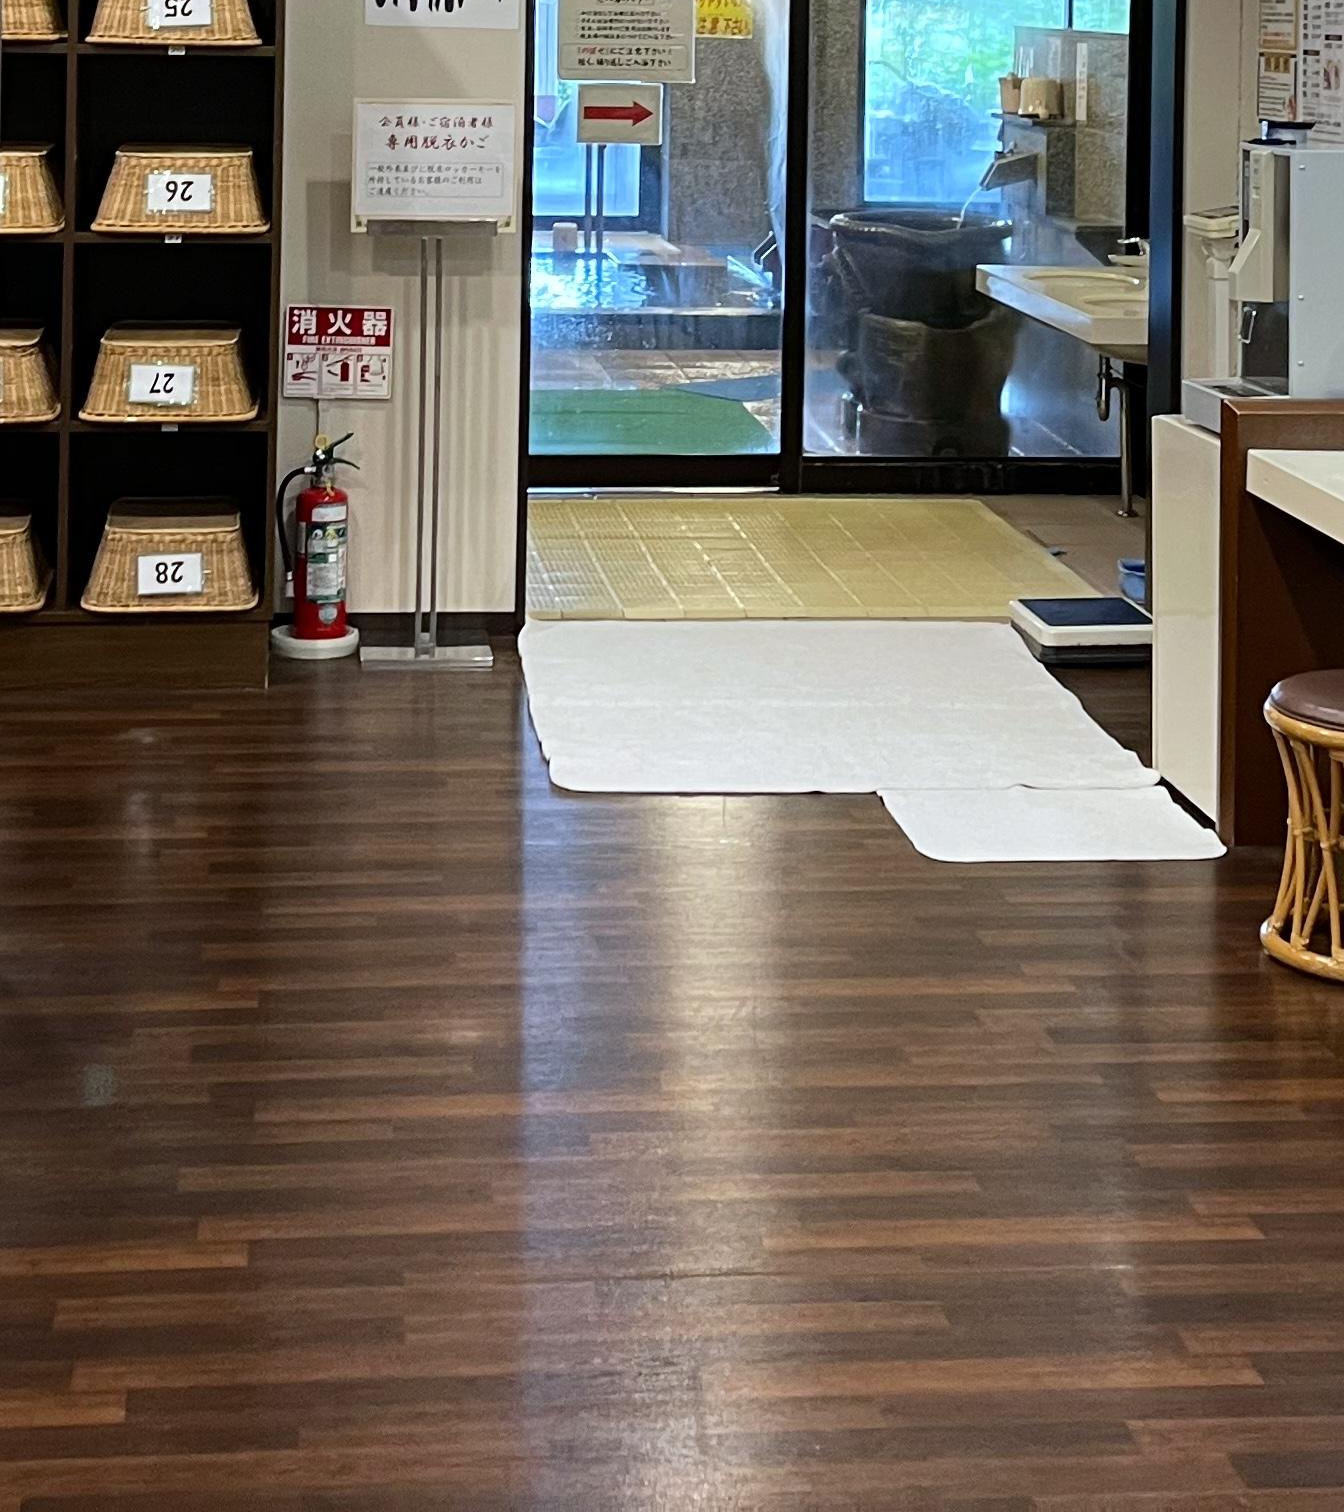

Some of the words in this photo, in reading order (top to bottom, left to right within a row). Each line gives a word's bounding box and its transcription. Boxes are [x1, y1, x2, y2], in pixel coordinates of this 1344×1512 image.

[386, 134, 490, 150] 専用脱衣かご
[165, 180, 194, 202] 26
[291, 309, 388, 336] 消火器
[149, 373, 175, 394] 27
[155, 561, 184, 584] 28
